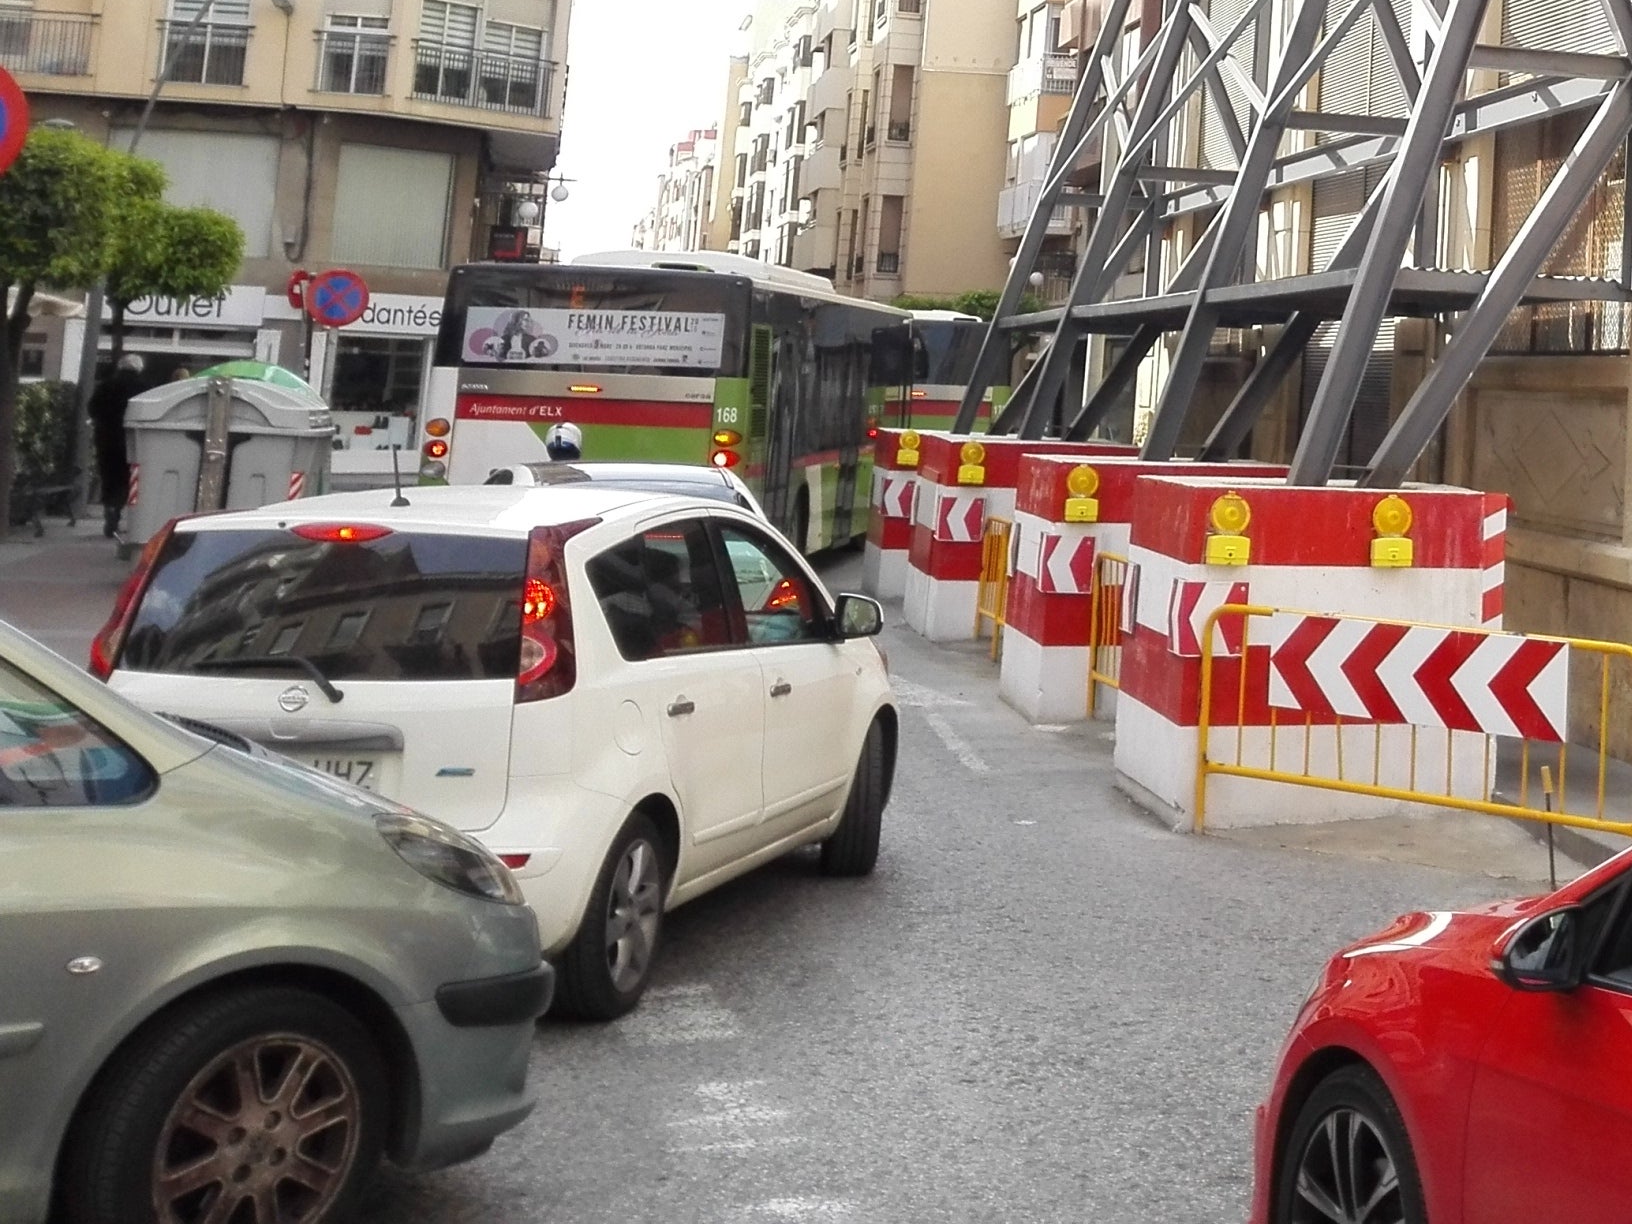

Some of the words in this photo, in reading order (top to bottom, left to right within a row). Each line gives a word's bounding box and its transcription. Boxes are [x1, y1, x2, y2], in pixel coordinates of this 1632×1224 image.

[568, 314, 614, 331] FEMIN
[621, 315, 690, 332] FESTIVAL
[469, 403, 526, 416] Ajuntament
[717, 407, 737, 423] 168
